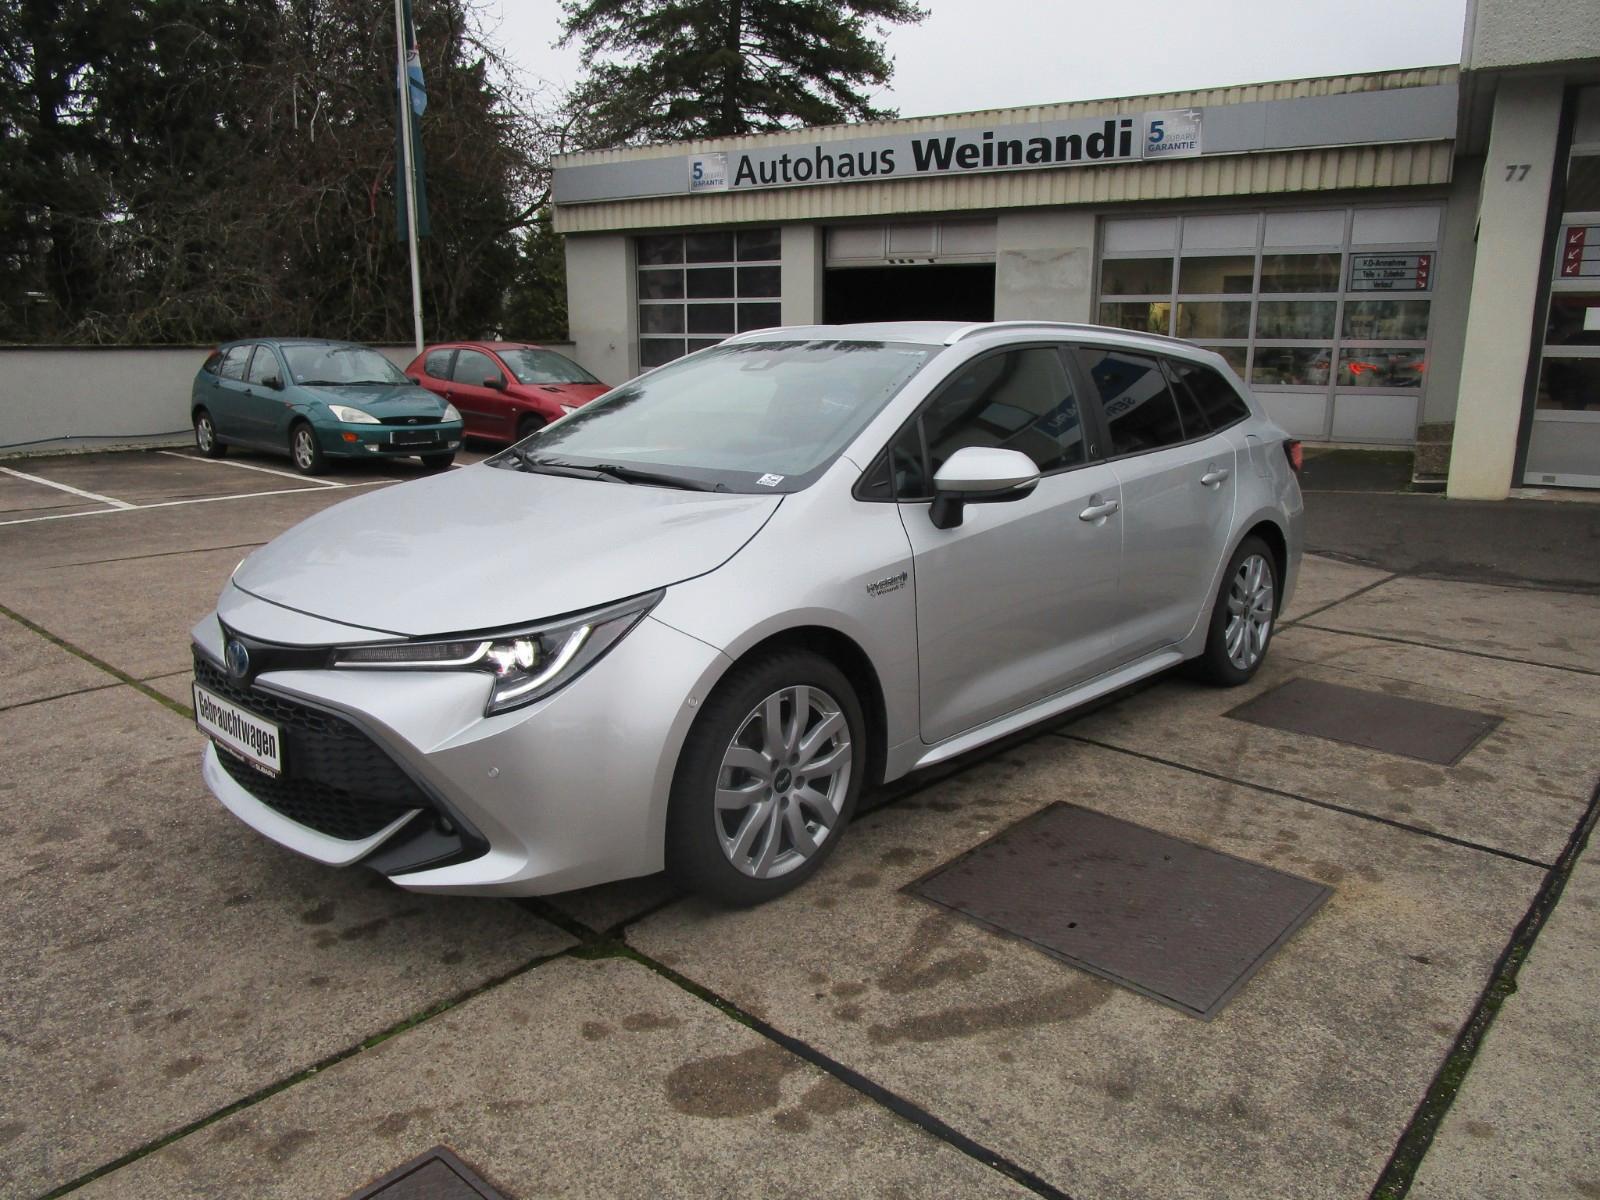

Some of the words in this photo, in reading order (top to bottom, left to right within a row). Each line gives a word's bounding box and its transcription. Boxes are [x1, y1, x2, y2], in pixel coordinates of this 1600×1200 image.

[1149, 121, 1164, 143] 5
[734, 146, 896, 186] Autohaus
[911, 119, 1133, 171] Weinandi
[1148, 141, 1196, 151] GARANTIE
[692, 161, 703, 180] 5
[1505, 165, 1531, 182] 77
[198, 690, 277, 759] Gebrauchtwagen
